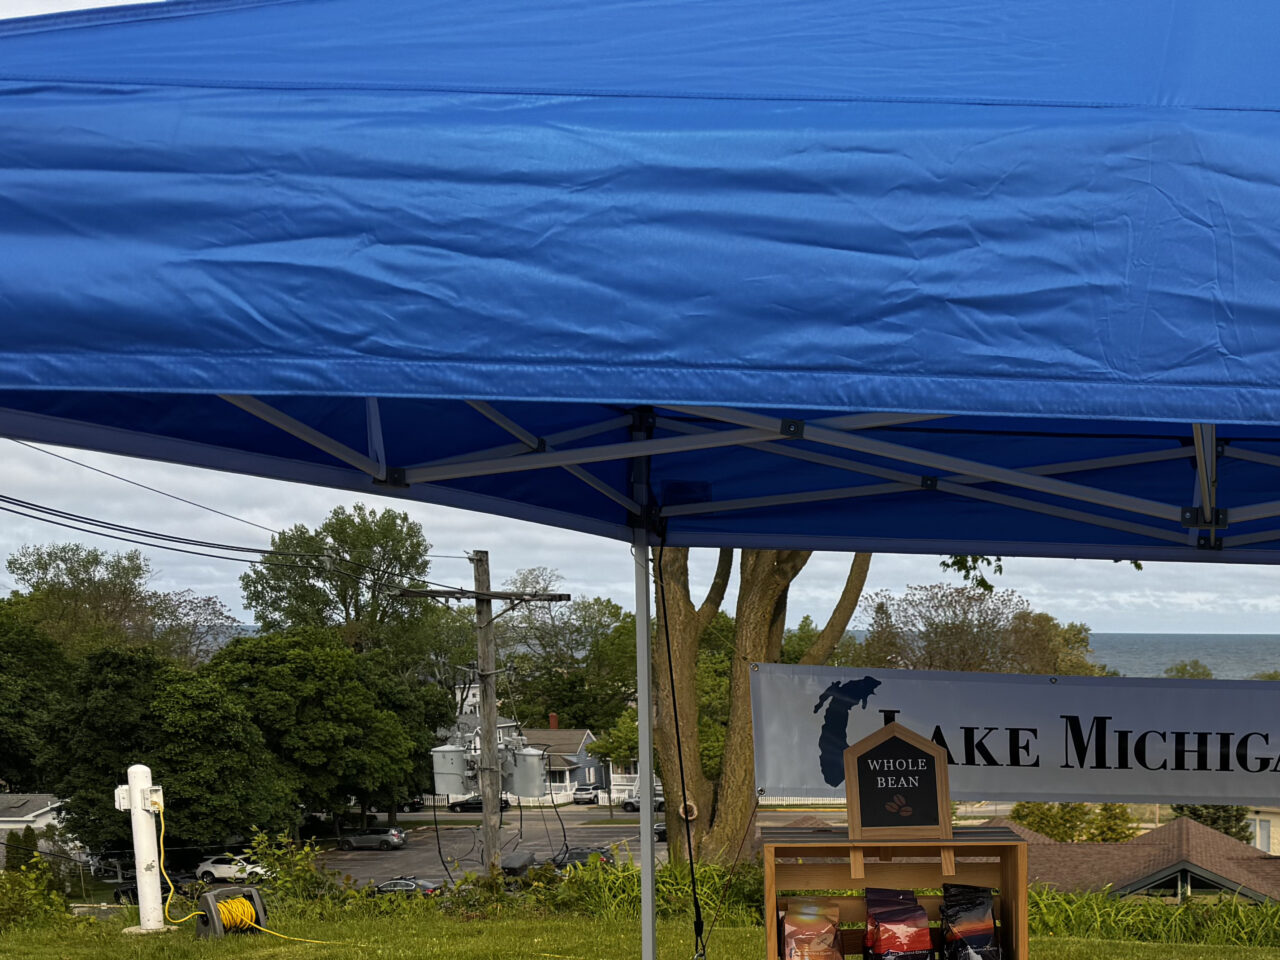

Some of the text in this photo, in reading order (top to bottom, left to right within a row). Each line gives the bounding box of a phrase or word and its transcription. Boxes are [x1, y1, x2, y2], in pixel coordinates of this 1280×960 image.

[879, 710, 1040, 768] AKE
[868, 758, 928, 772] WHOLE
[876, 775, 920, 789] BEAN
